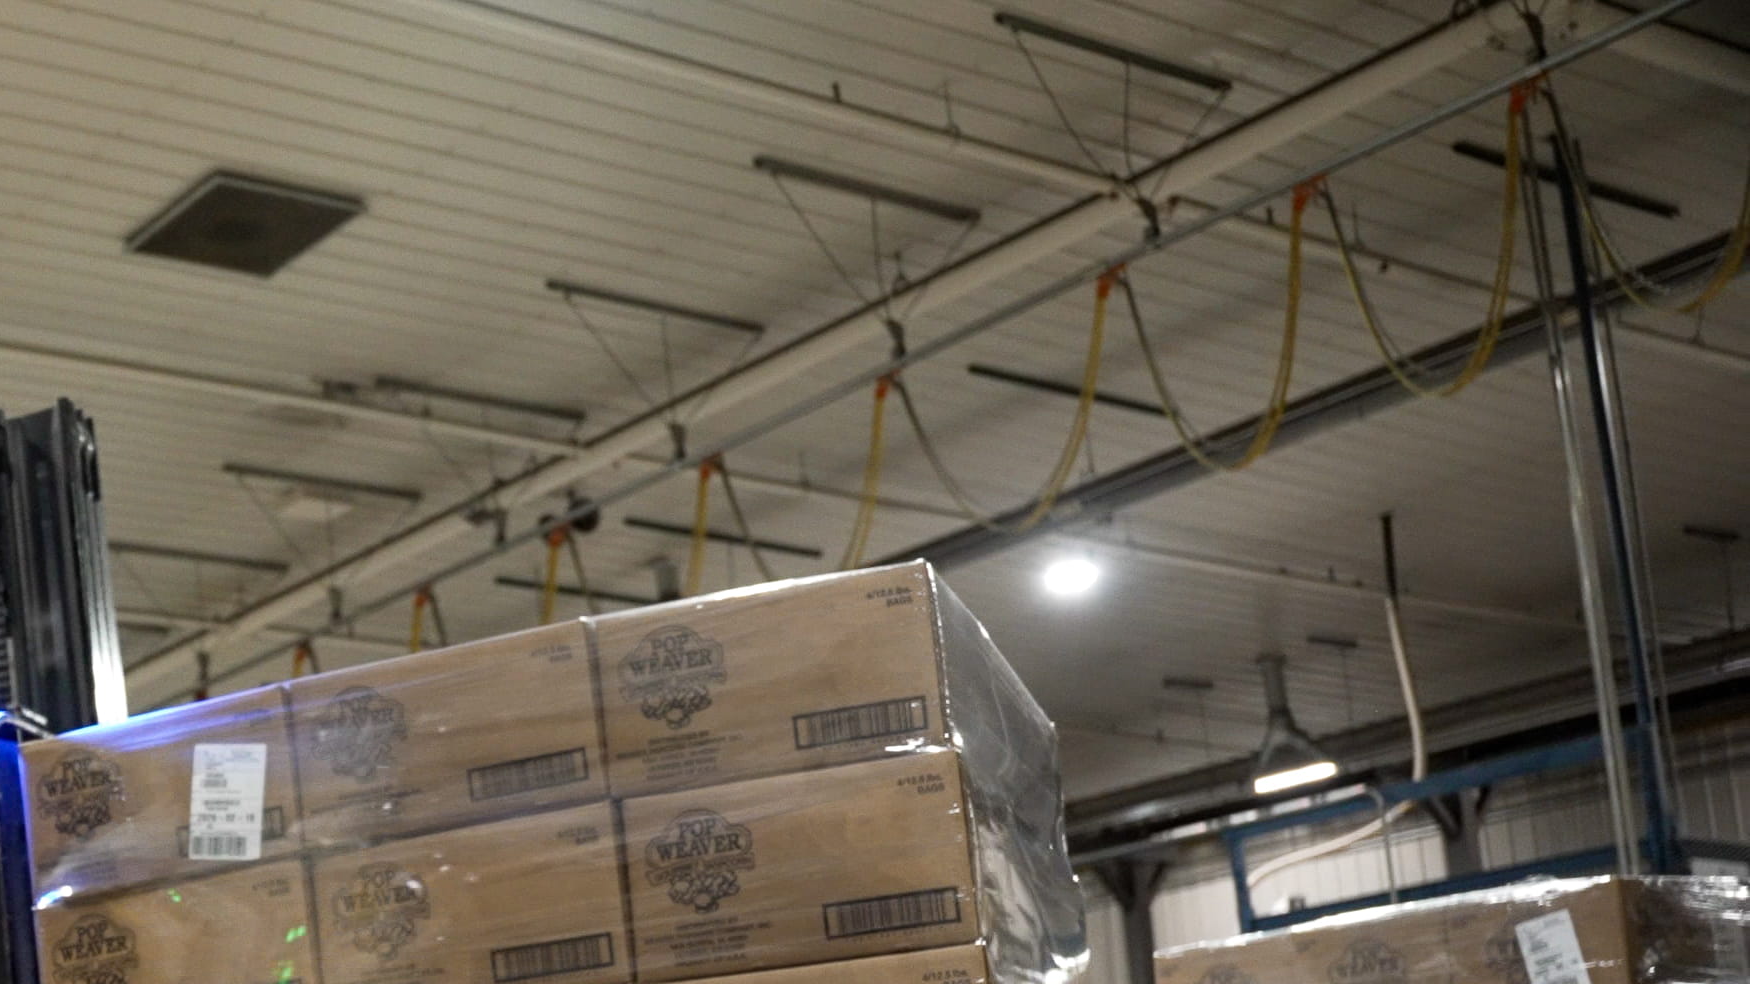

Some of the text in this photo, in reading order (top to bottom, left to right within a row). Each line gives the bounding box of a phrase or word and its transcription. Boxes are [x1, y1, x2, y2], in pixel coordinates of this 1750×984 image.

[650, 631, 689, 651] POP
[628, 648, 712, 675] WEAVER
[678, 817, 716, 838] POP
[656, 833, 740, 861] WEAVER
[75, 920, 108, 943] POP
[59, 935, 127, 962] WEAVER
